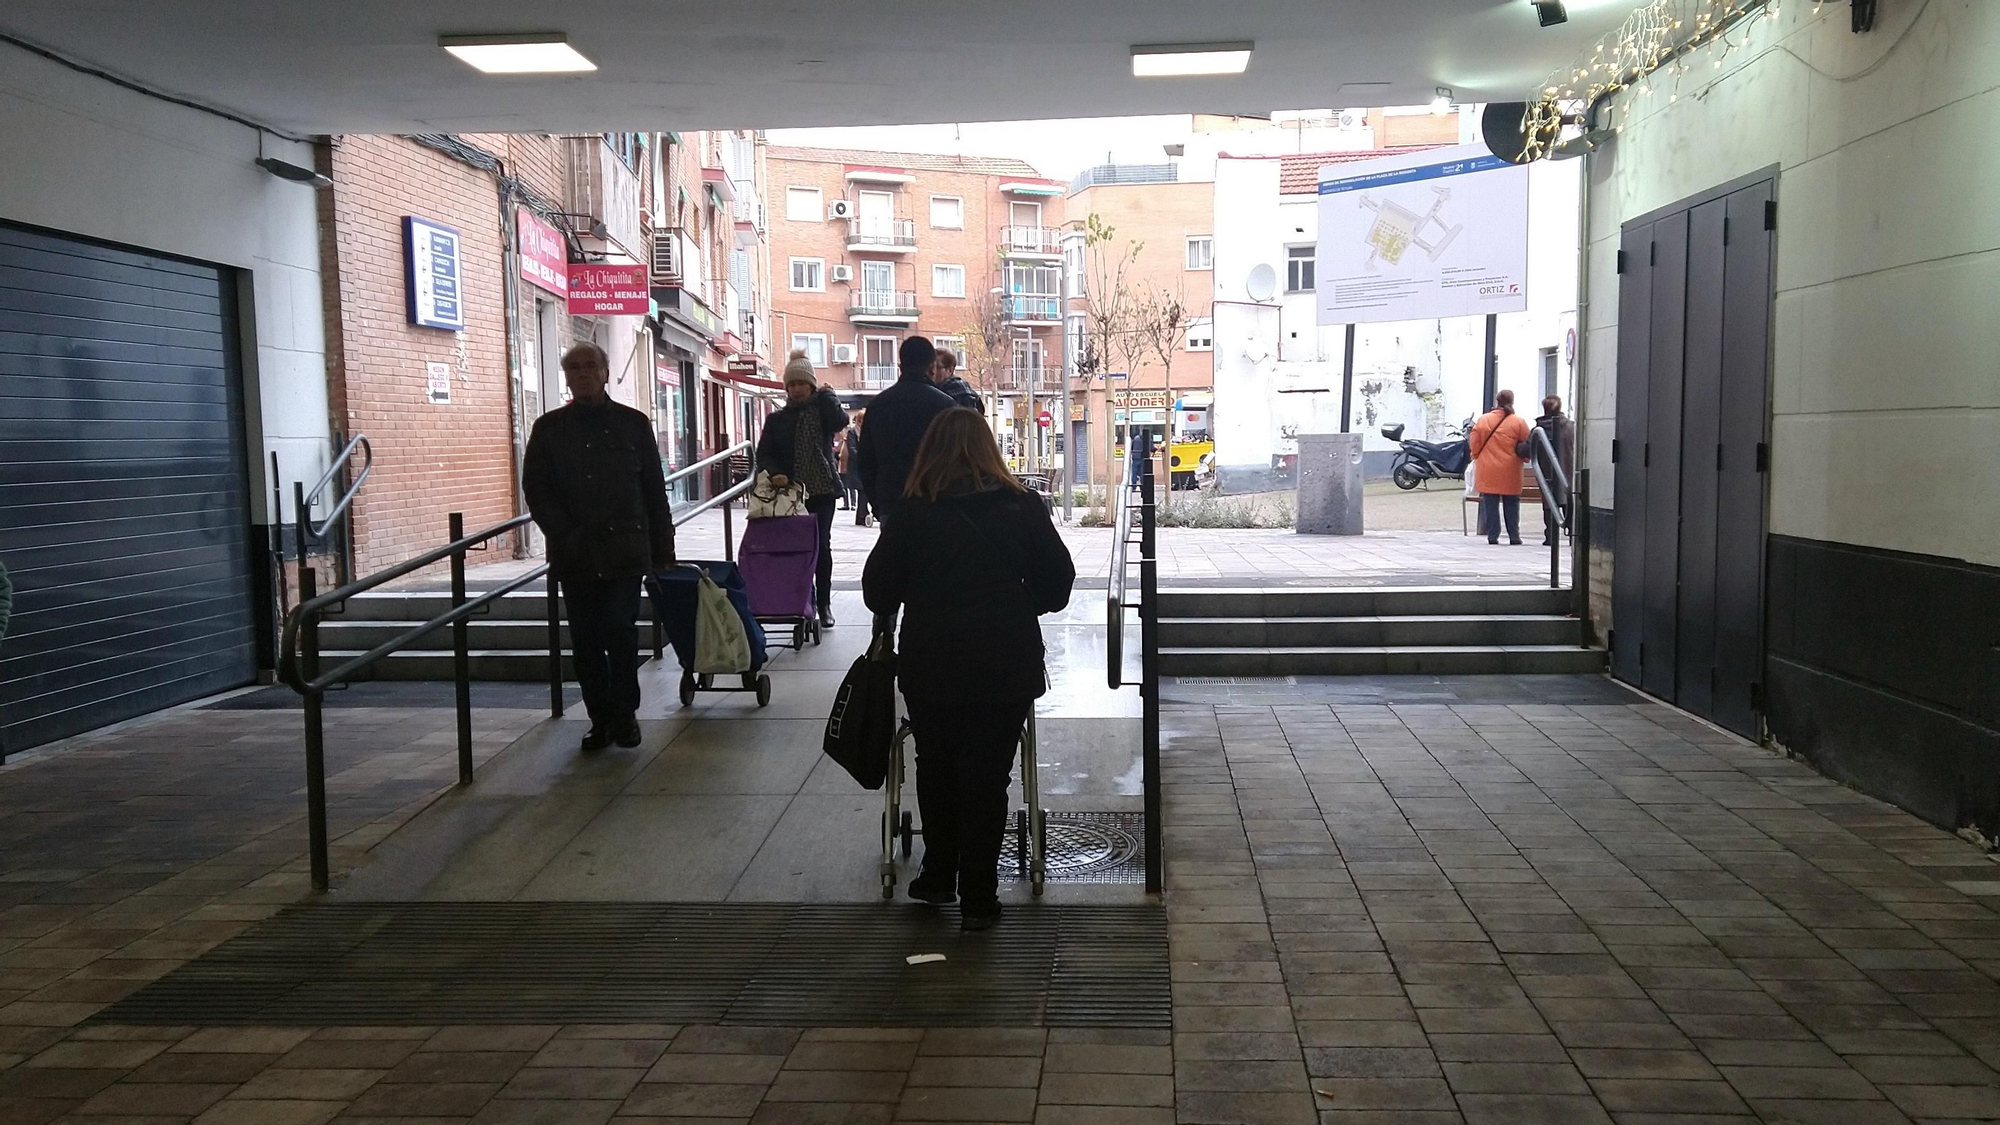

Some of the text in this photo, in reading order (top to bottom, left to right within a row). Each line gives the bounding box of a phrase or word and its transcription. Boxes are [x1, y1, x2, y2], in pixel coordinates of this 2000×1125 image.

[584, 270, 632, 290] La Chiquitita
[1479, 286, 1504, 294] ORTIZ
[570, 291, 607, 299] REGALOS
[614, 291, 647, 299] MENAJE
